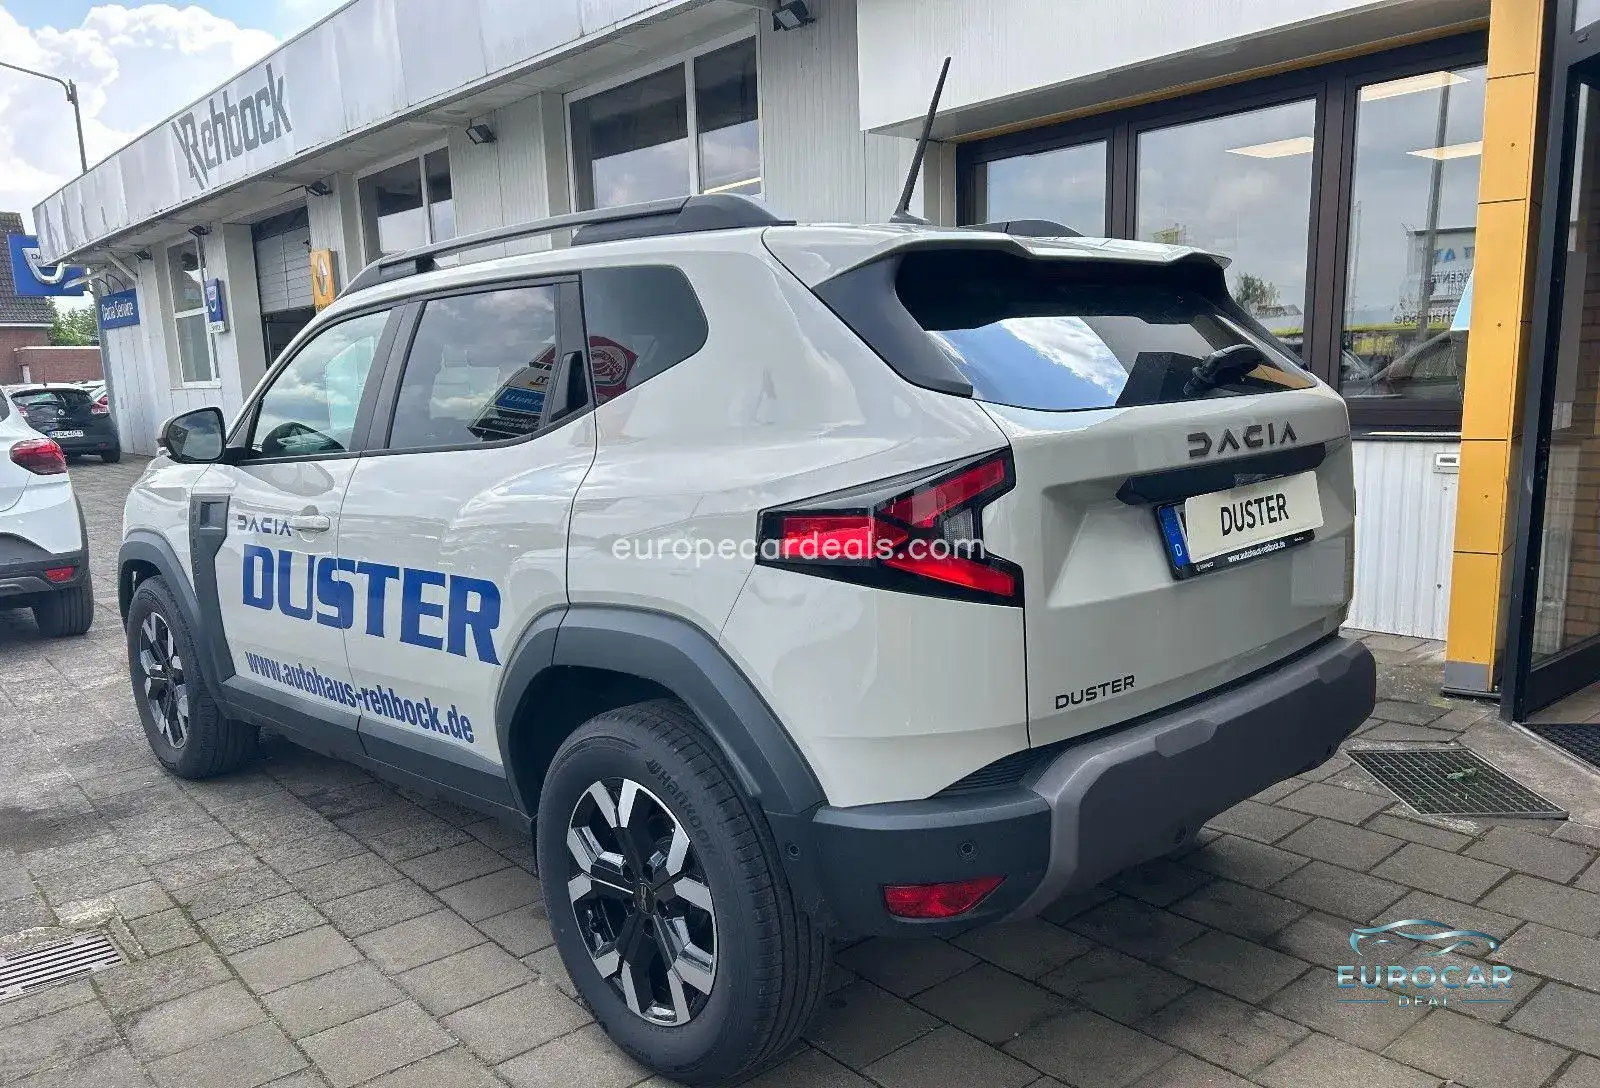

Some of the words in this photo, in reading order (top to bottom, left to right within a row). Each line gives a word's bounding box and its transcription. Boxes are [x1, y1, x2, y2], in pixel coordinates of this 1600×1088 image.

[171, 62, 293, 190] Rehbock
[1187, 421, 1297, 457] DACIA
[238, 514, 291, 537] DACIA
[1220, 493, 1290, 536] DUSTER
[242, 543, 502, 666] DUSTER
[244, 651, 475, 744] www.autohaus-rehbock.de
[1055, 675, 1135, 710] DUSTER
